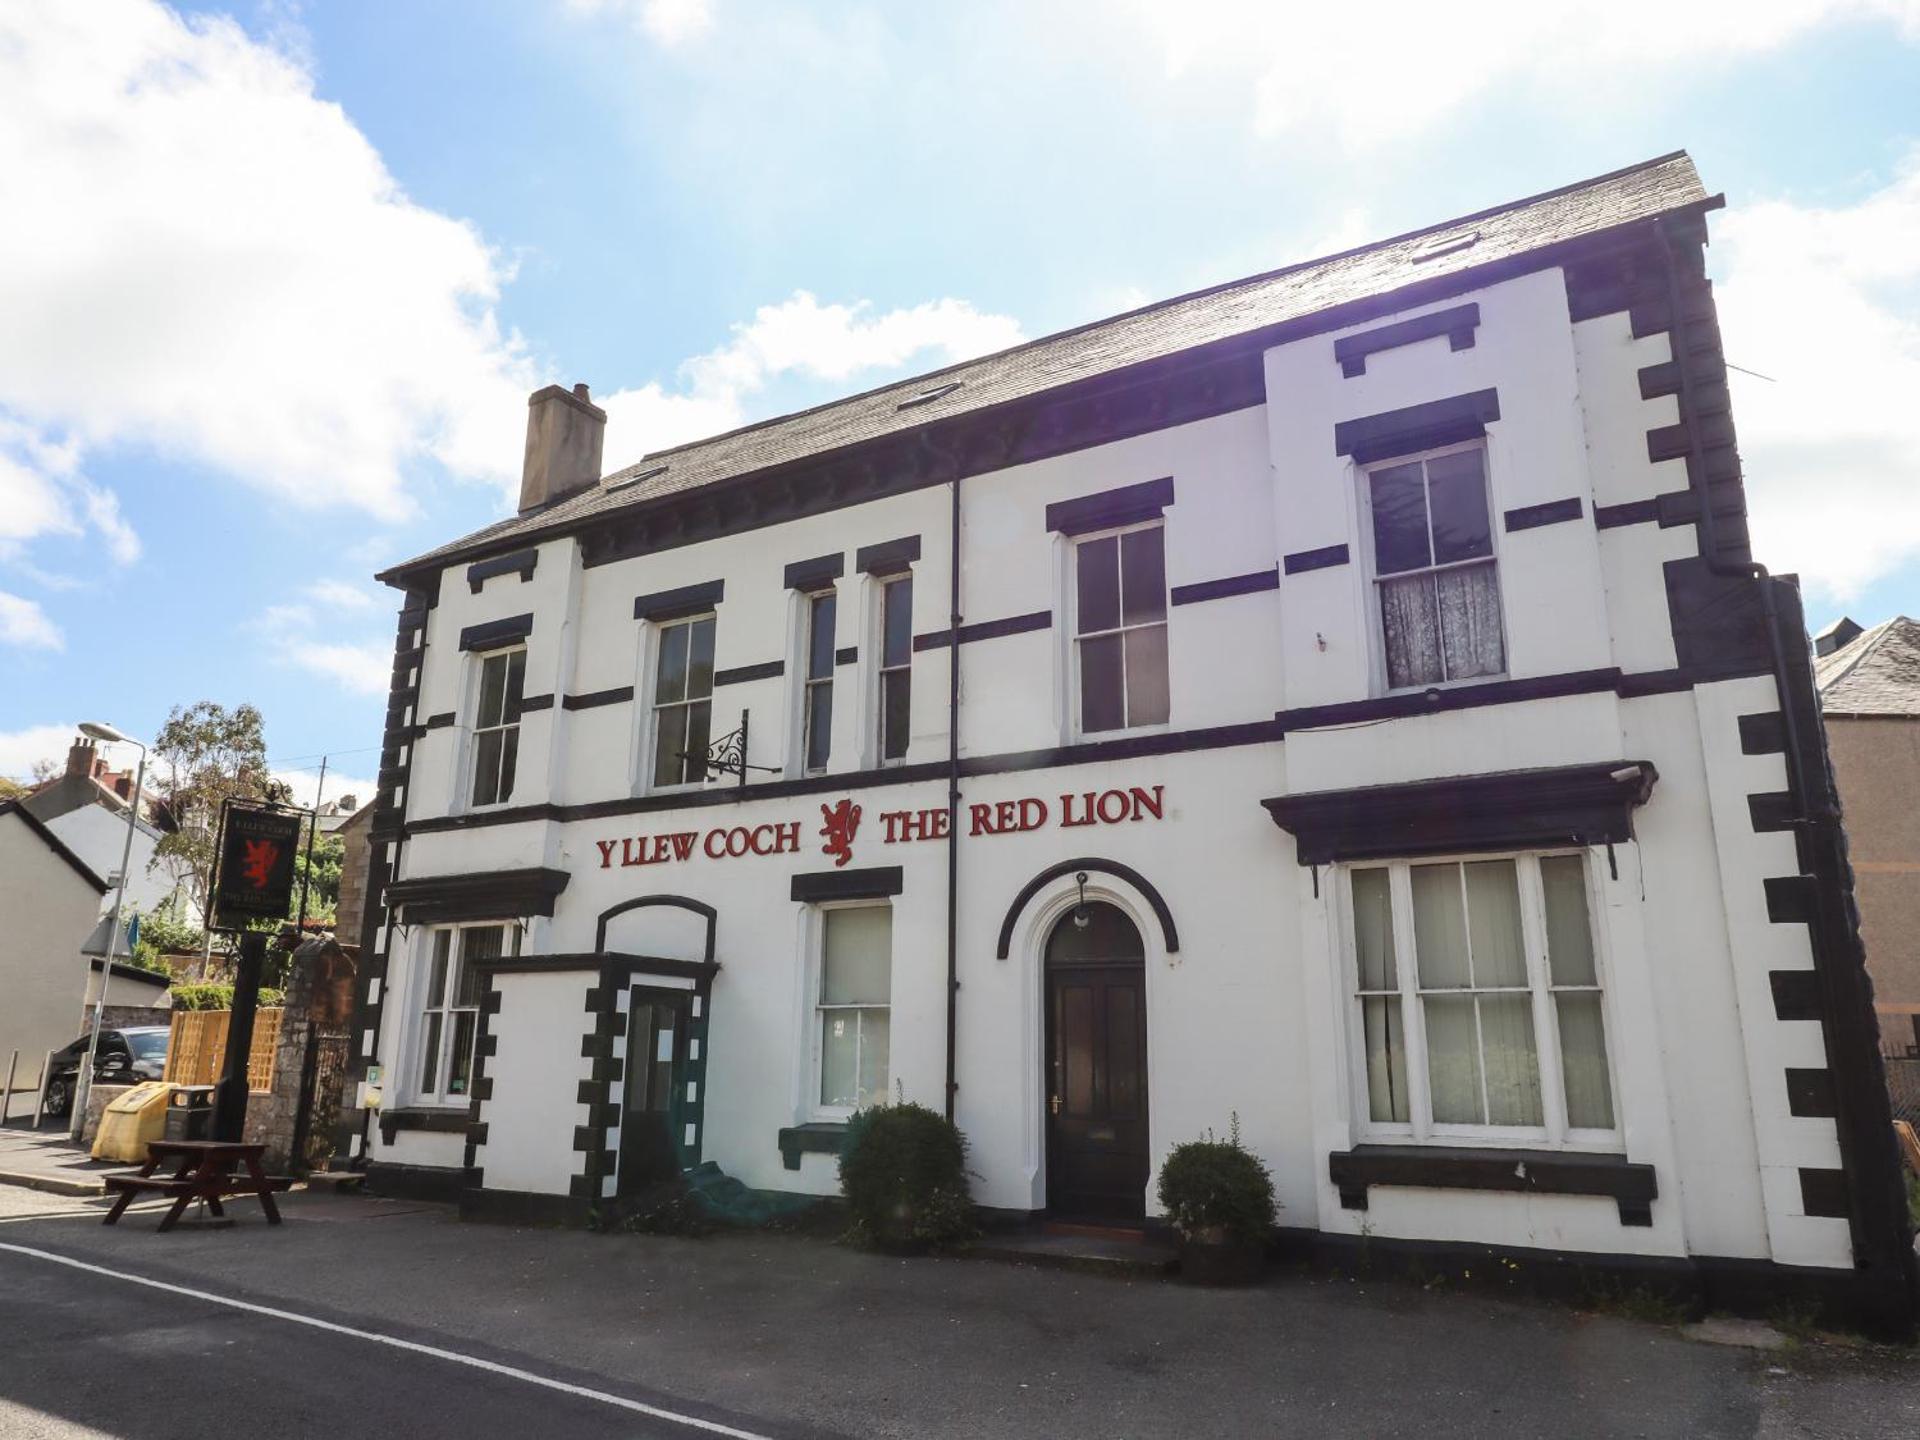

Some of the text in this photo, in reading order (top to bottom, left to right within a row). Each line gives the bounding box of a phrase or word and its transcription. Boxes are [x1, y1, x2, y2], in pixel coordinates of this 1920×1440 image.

[596, 785, 1164, 868] Y LLEW COCH THE RED LION
